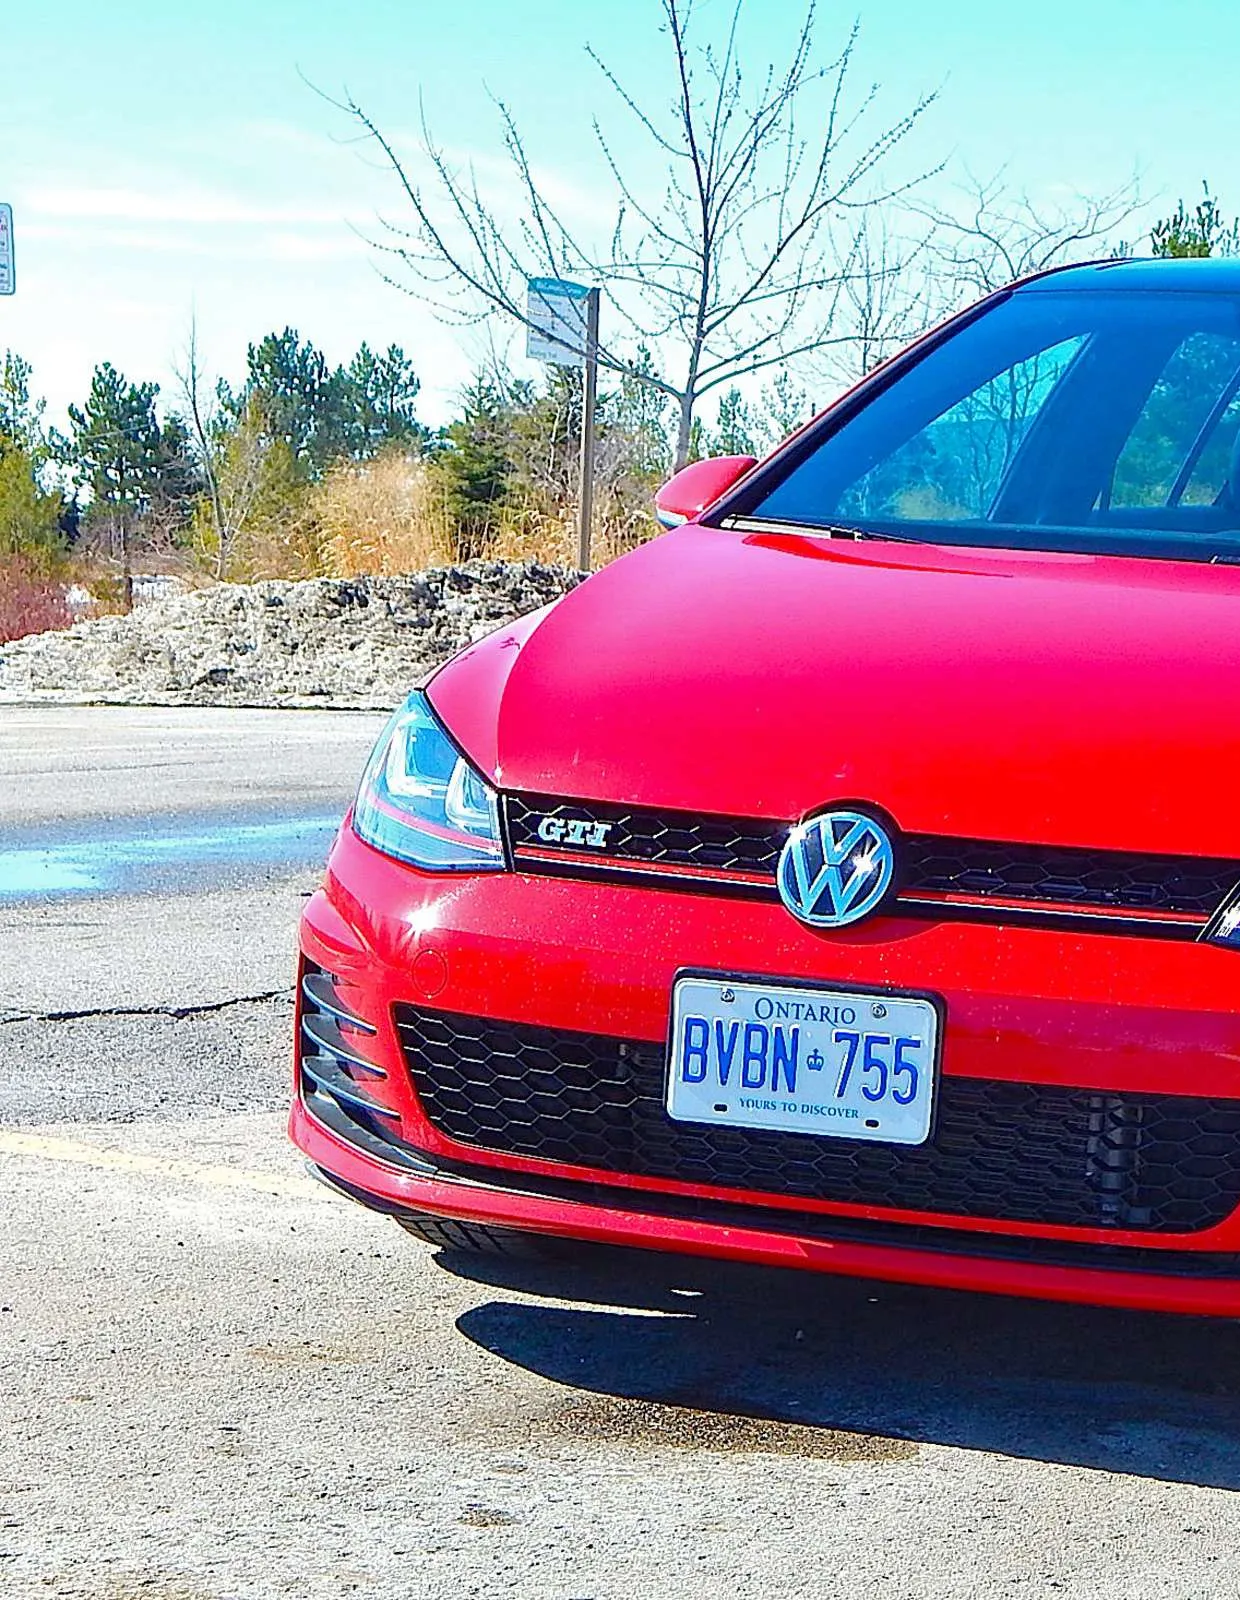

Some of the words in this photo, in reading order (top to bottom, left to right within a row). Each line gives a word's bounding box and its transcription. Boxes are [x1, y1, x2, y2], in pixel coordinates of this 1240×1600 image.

[537, 817, 612, 848] GTI
[682, 1018, 800, 1093] BVBN
[833, 1030, 921, 1105] 755
[739, 1097, 777, 1111] YOURS
[781, 1101, 798, 1113] TO
[801, 1104, 859, 1119] DISCOVER
